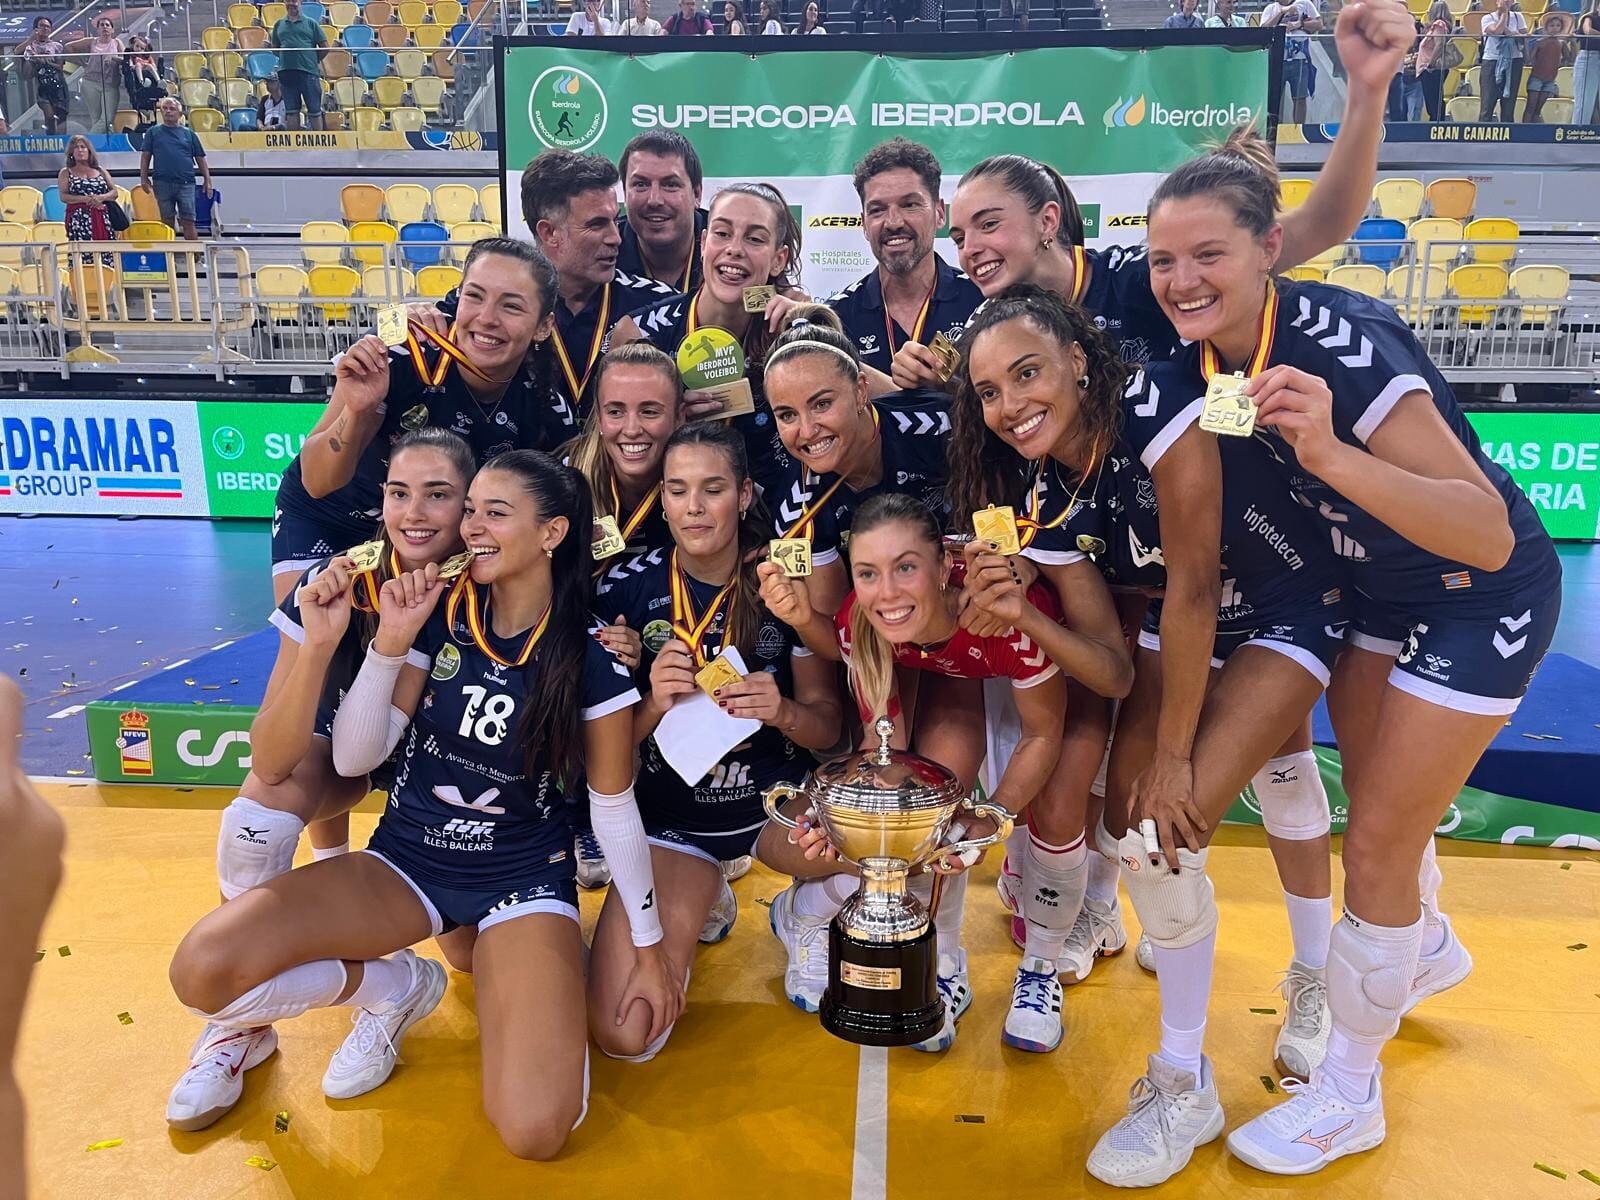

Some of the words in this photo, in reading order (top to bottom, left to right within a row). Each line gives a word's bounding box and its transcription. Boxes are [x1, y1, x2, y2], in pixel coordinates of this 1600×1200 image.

[552, 101, 580, 109] Iberdrola
[632, 103, 857, 129] SUPERCOPA
[871, 101, 1085, 127] IBERDROLA
[1150, 102, 1251, 128] Iberdrola
[265, 134, 293, 148] GRAN
[296, 133, 338, 148] CANARIA
[1430, 126, 1460, 141] GRAN
[1463, 126, 1510, 141] CANARIA
[24, 138, 65, 151] CANARIA
[821, 250, 862, 258] Hospitales
[821, 257, 839, 265] SAN
[840, 257, 870, 266] ROQUE
[715, 345, 735, 358] MVP
[697, 356, 737, 372] IBERDROLA
[705, 365, 739, 380] VOLEIBOL
[0, 416, 180, 473] DRAMAR
[1550, 442, 1600, 471] DE
[16, 474, 93, 497] GROUP
[483, 671, 508, 686] hummel
[1416, 665, 1450, 681] hummel
[458, 684, 515, 746] 18
[446, 752, 475, 768] Avarca
[476, 763, 488, 772] de
[423, 835, 448, 849] ILLES
[449, 841, 494, 852] BALEARS
